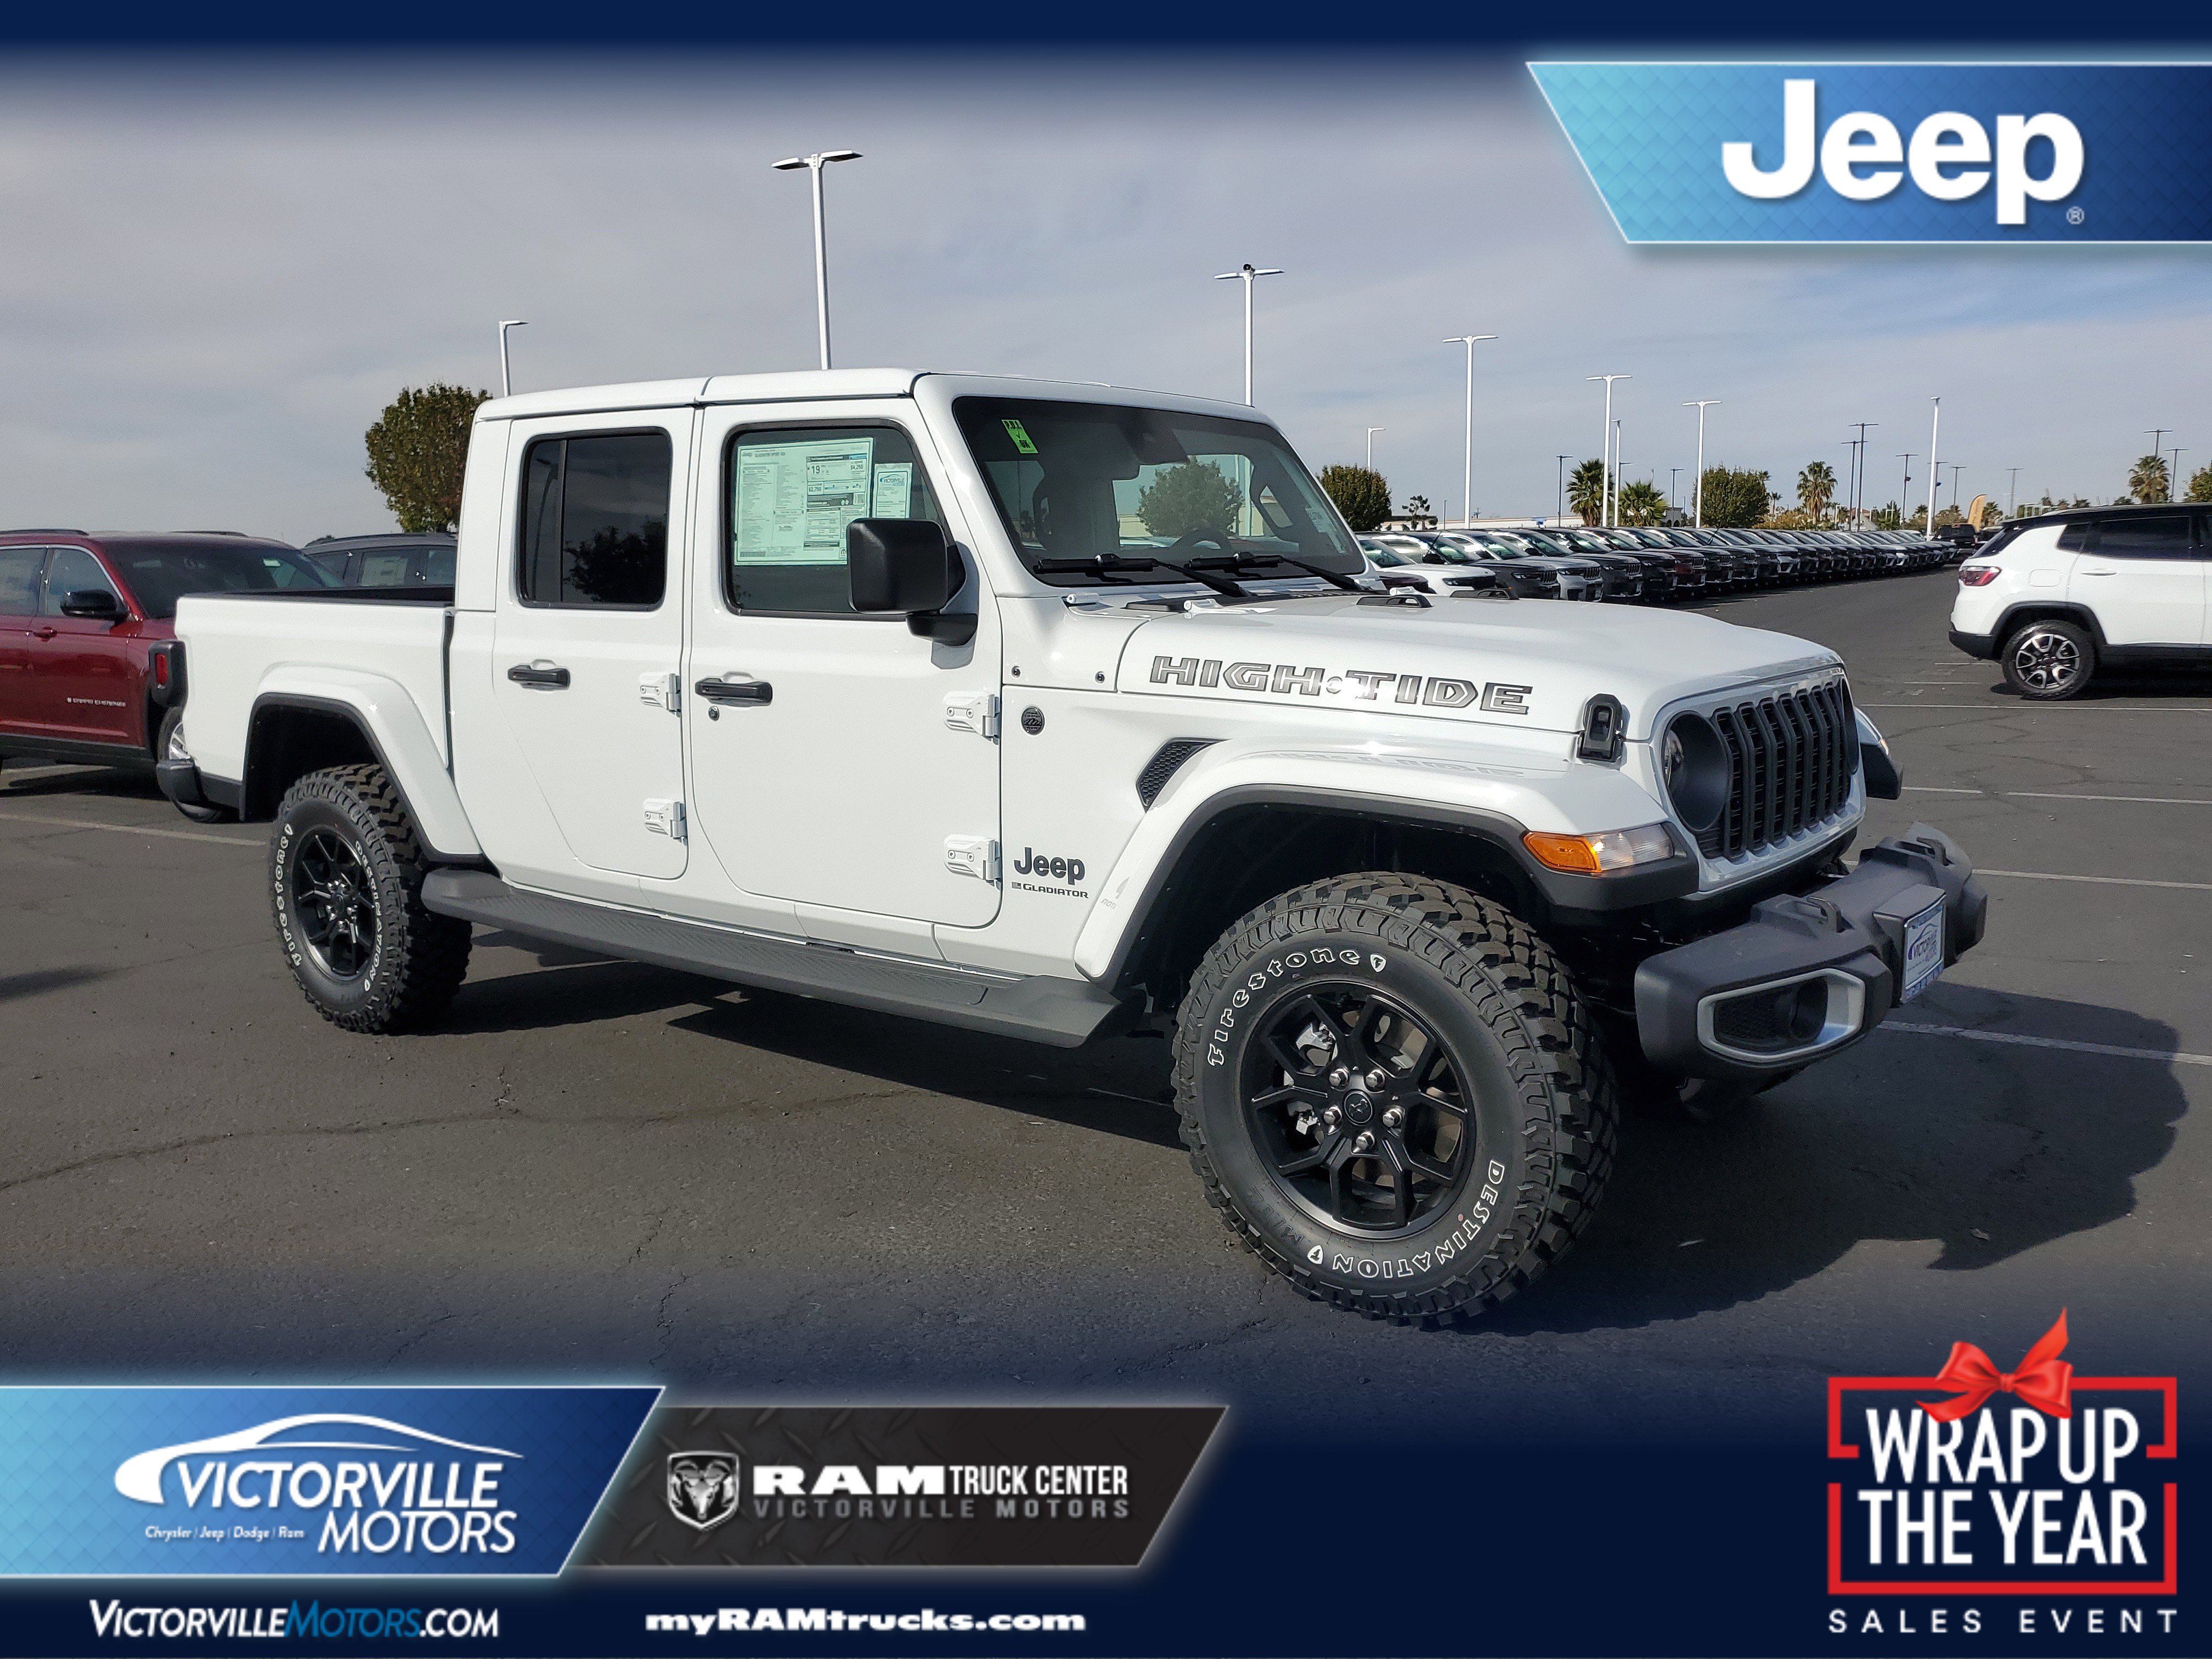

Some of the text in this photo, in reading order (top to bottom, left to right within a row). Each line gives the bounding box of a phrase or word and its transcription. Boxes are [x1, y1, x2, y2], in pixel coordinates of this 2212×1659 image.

[1018, 439, 1031, 448] OK
[811, 465, 820, 474] 19
[1149, 655, 1533, 715] HIGH TIDE
[1013, 847, 1085, 886] Jeep
[1023, 883, 1089, 899] GLADIATOR
[1207, 948, 1361, 1066] Firestone
[1332, 1159, 1505, 1279] DESTINATION
